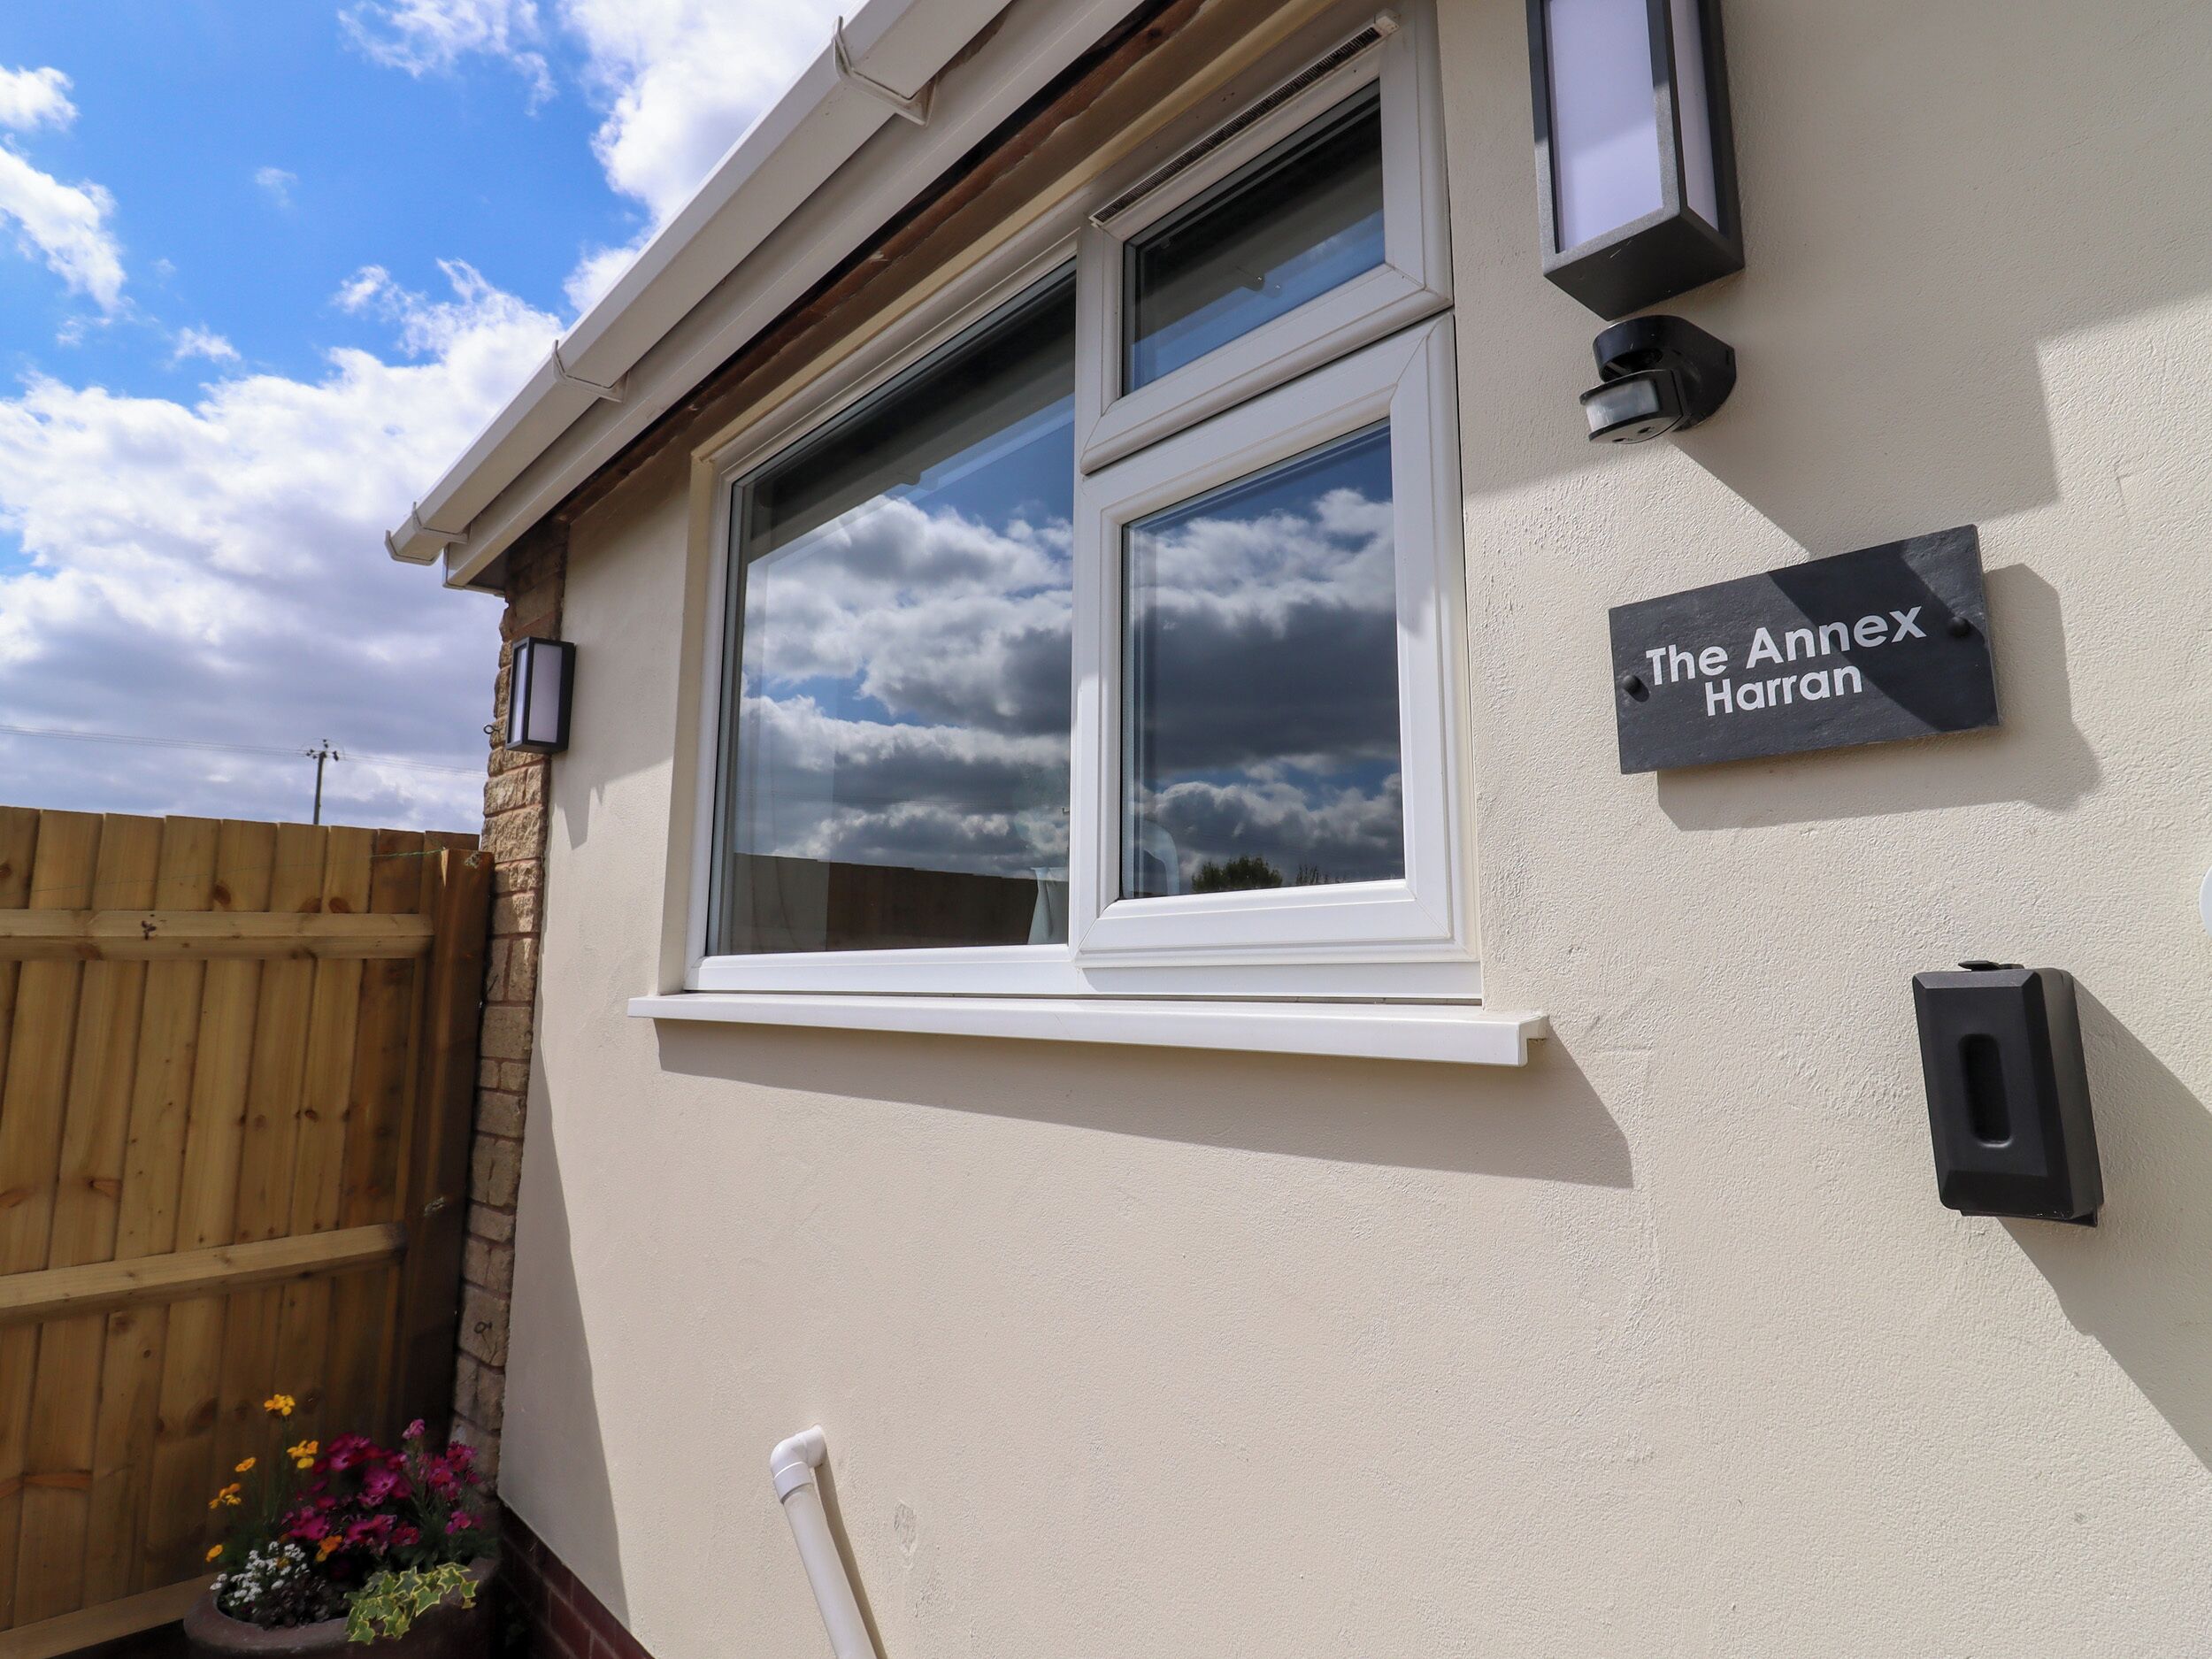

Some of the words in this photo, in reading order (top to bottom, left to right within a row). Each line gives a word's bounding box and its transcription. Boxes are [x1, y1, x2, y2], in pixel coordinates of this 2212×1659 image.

[1645, 644, 1729, 686] The
[1746, 605, 1927, 670] Annex
[1704, 666, 1863, 717] Harran
